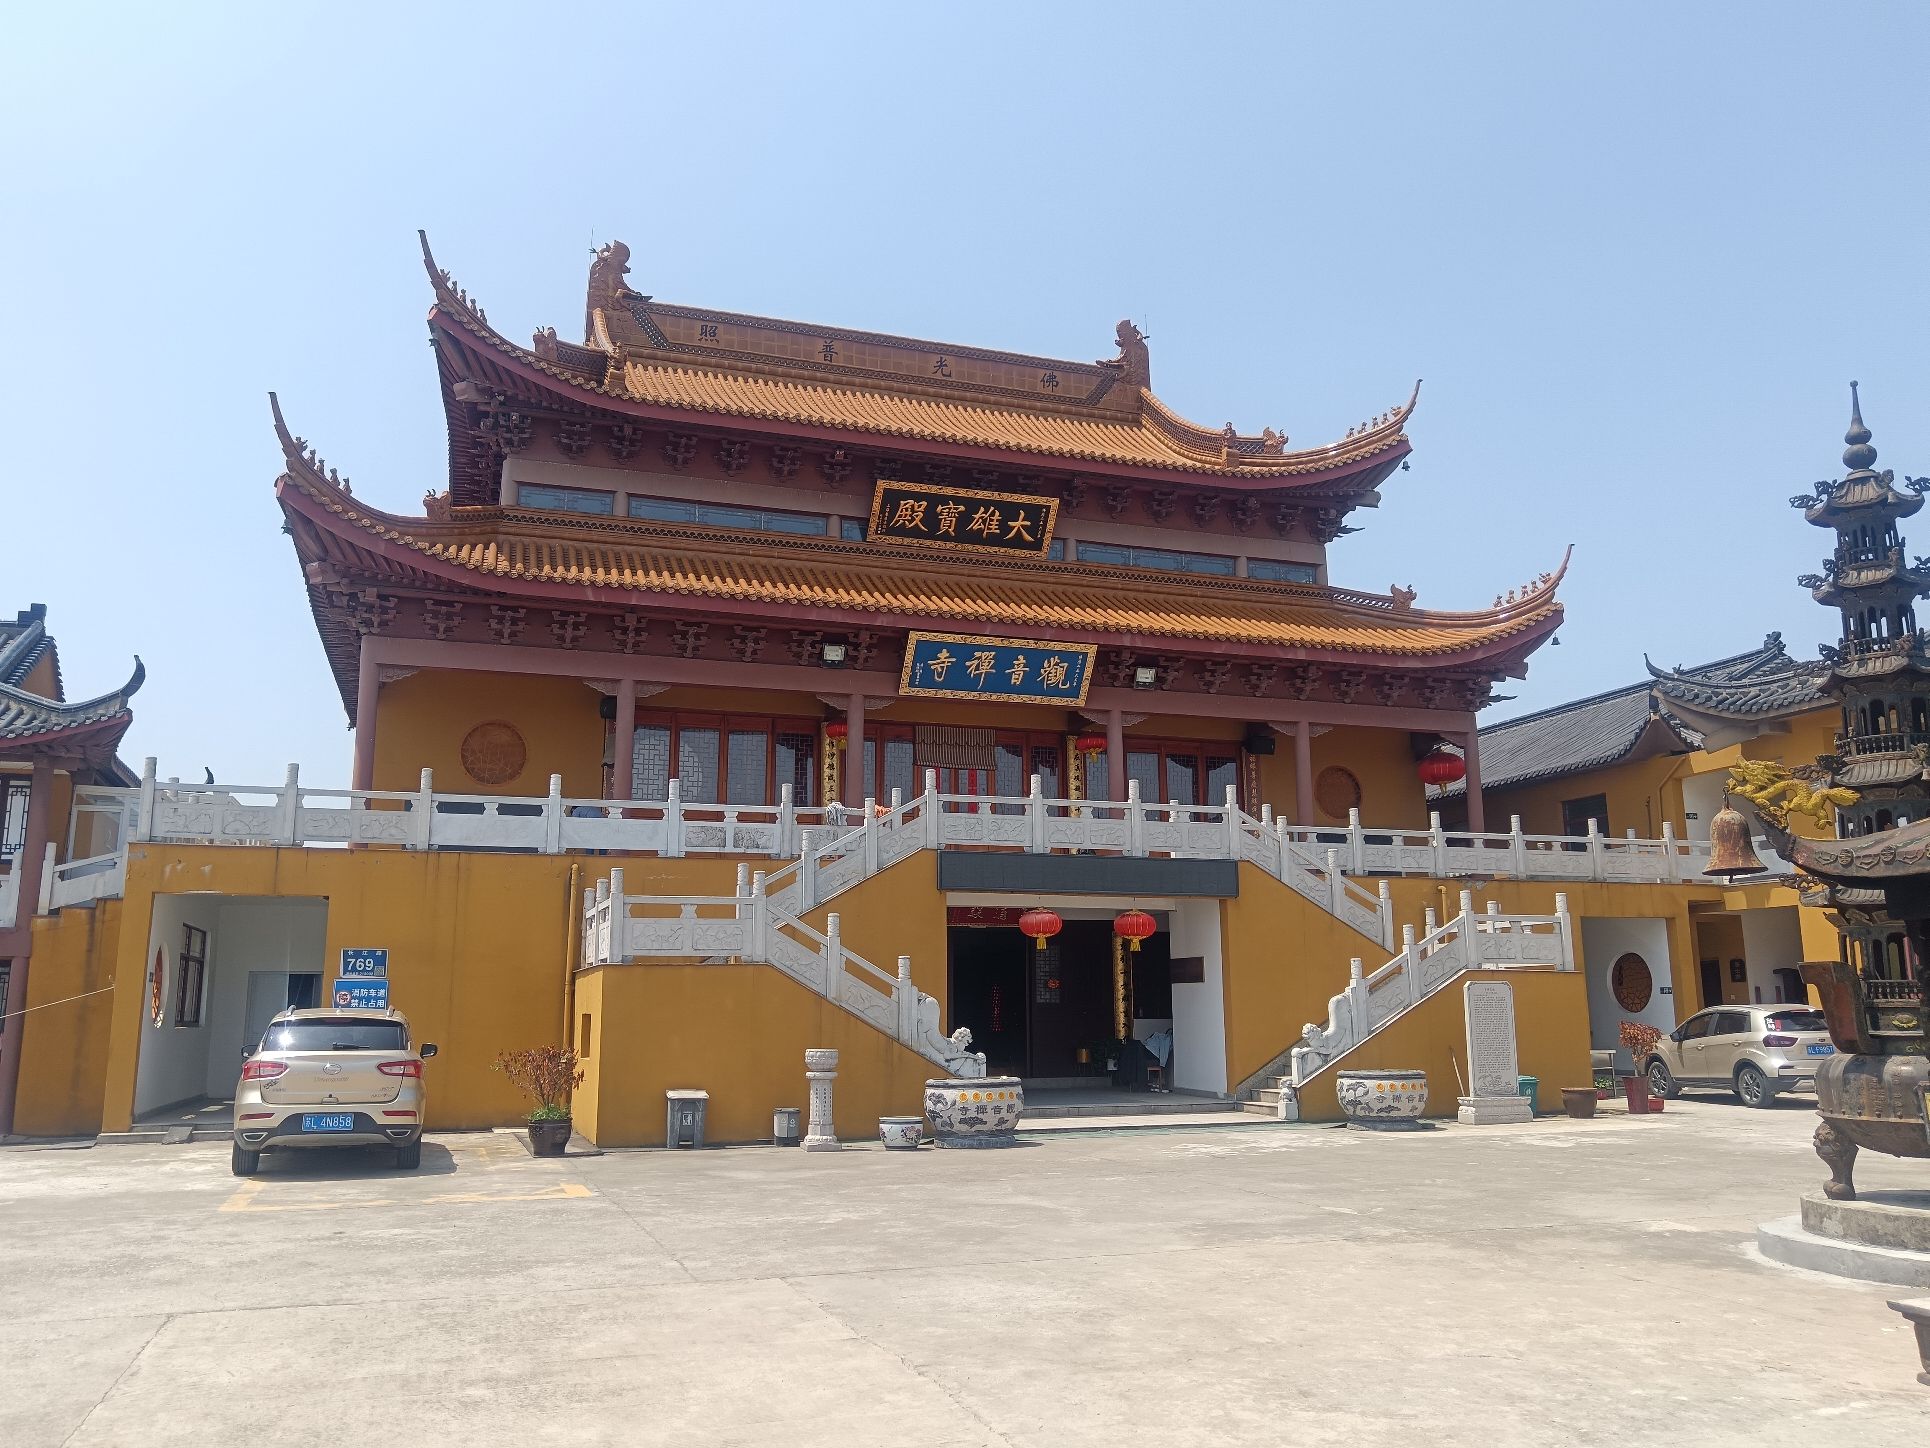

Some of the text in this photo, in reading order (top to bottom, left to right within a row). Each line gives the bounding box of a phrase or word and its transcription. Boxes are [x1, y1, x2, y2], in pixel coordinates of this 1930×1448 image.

[890, 500, 1035, 543] 大雄寶殿
[928, 649, 1070, 691] 觀音禪寺
[347, 958, 374, 970] 769
[351, 988, 386, 998] 消防车道
[350, 999, 385, 1008] 禁止占用
